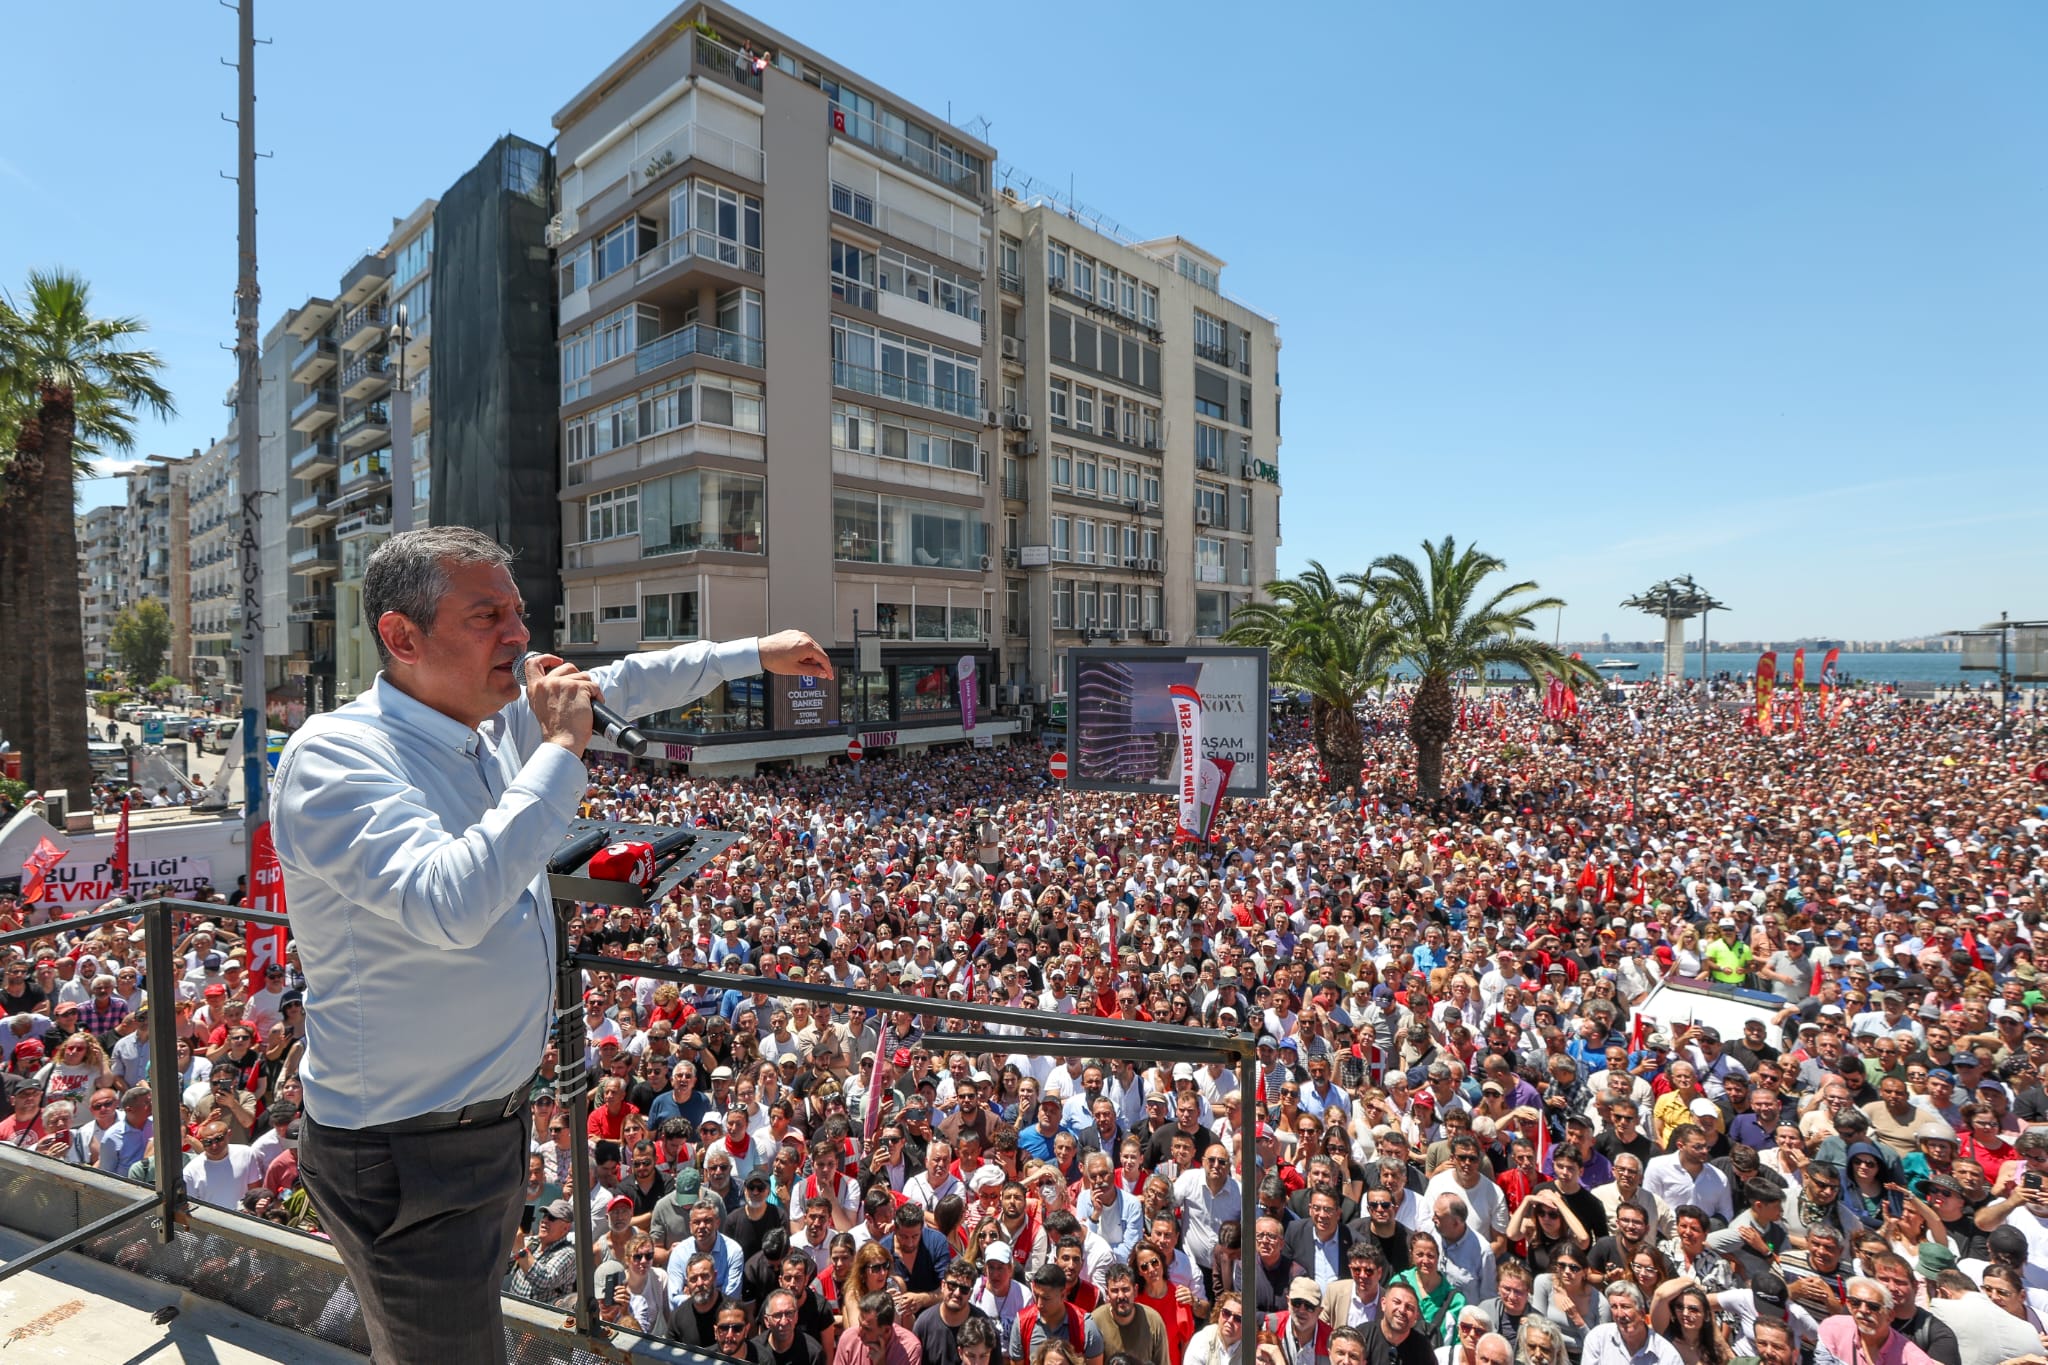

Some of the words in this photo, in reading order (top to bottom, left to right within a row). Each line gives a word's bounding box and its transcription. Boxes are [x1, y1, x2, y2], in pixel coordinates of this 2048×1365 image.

[788, 690, 828, 699] COLDWELL
[792, 699, 823, 708] BANKER
[1201, 699, 1245, 713] NOVA
[799, 711, 818, 719] STORM
[150, 722, 158, 730] P
[1201, 737, 1243, 751] AŞAM
[45, 867, 77, 883] BU
